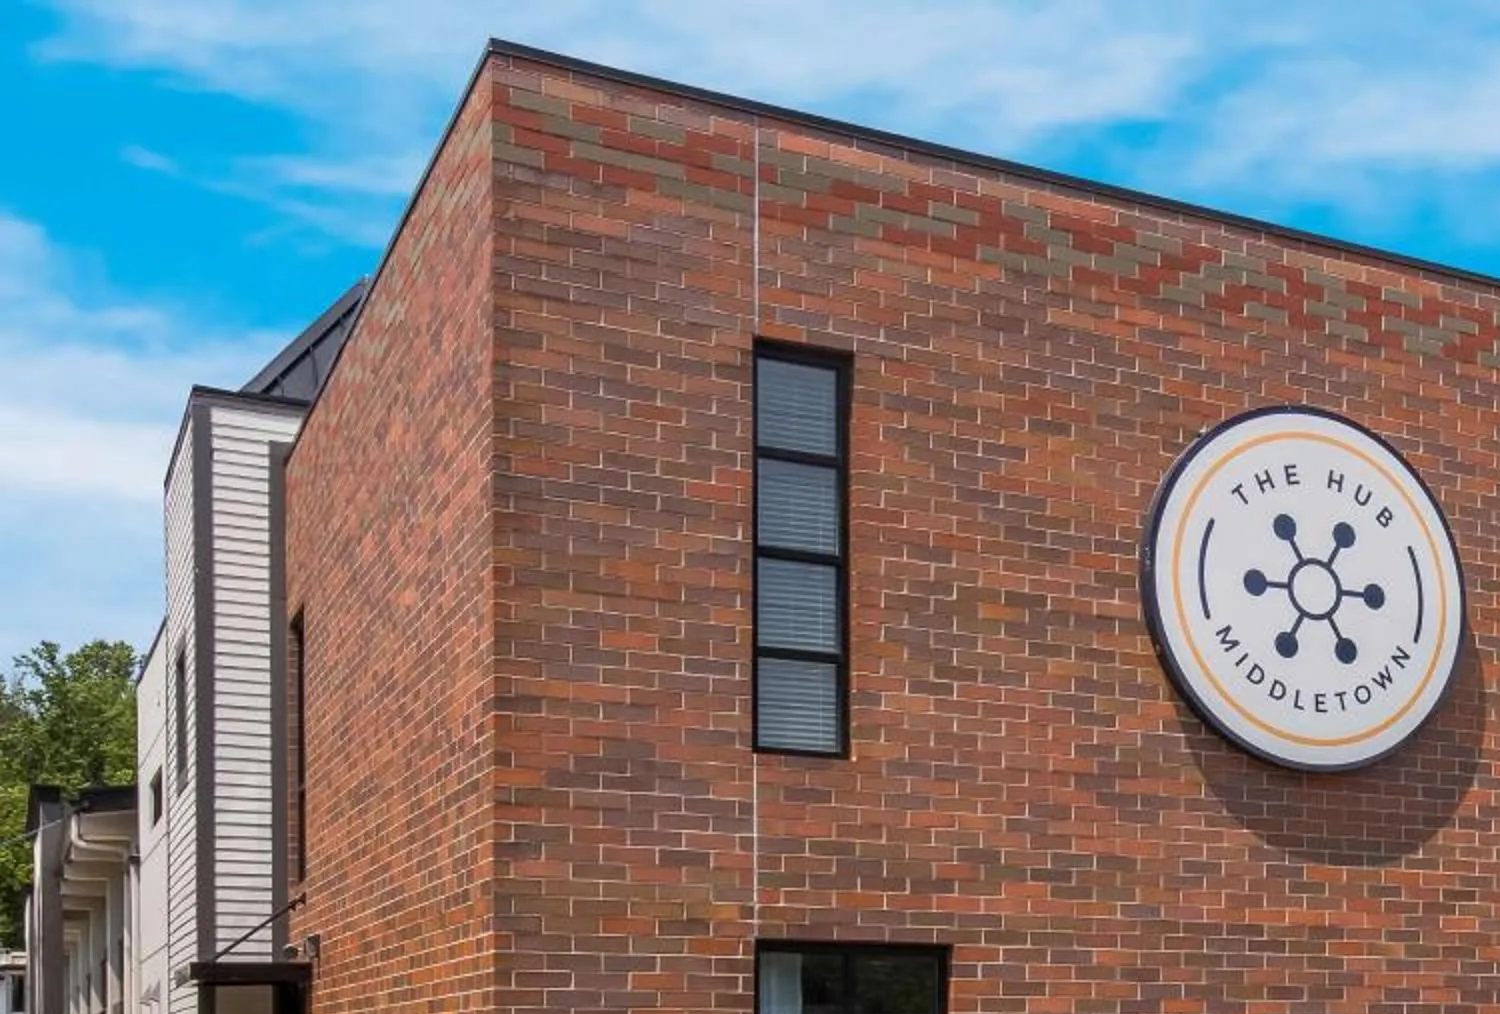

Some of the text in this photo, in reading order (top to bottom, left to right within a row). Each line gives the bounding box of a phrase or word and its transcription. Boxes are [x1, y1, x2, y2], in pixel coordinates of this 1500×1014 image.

[1231, 463, 1395, 529] THE HUB
[1214, 624, 1412, 713] MIDDLETOWN
